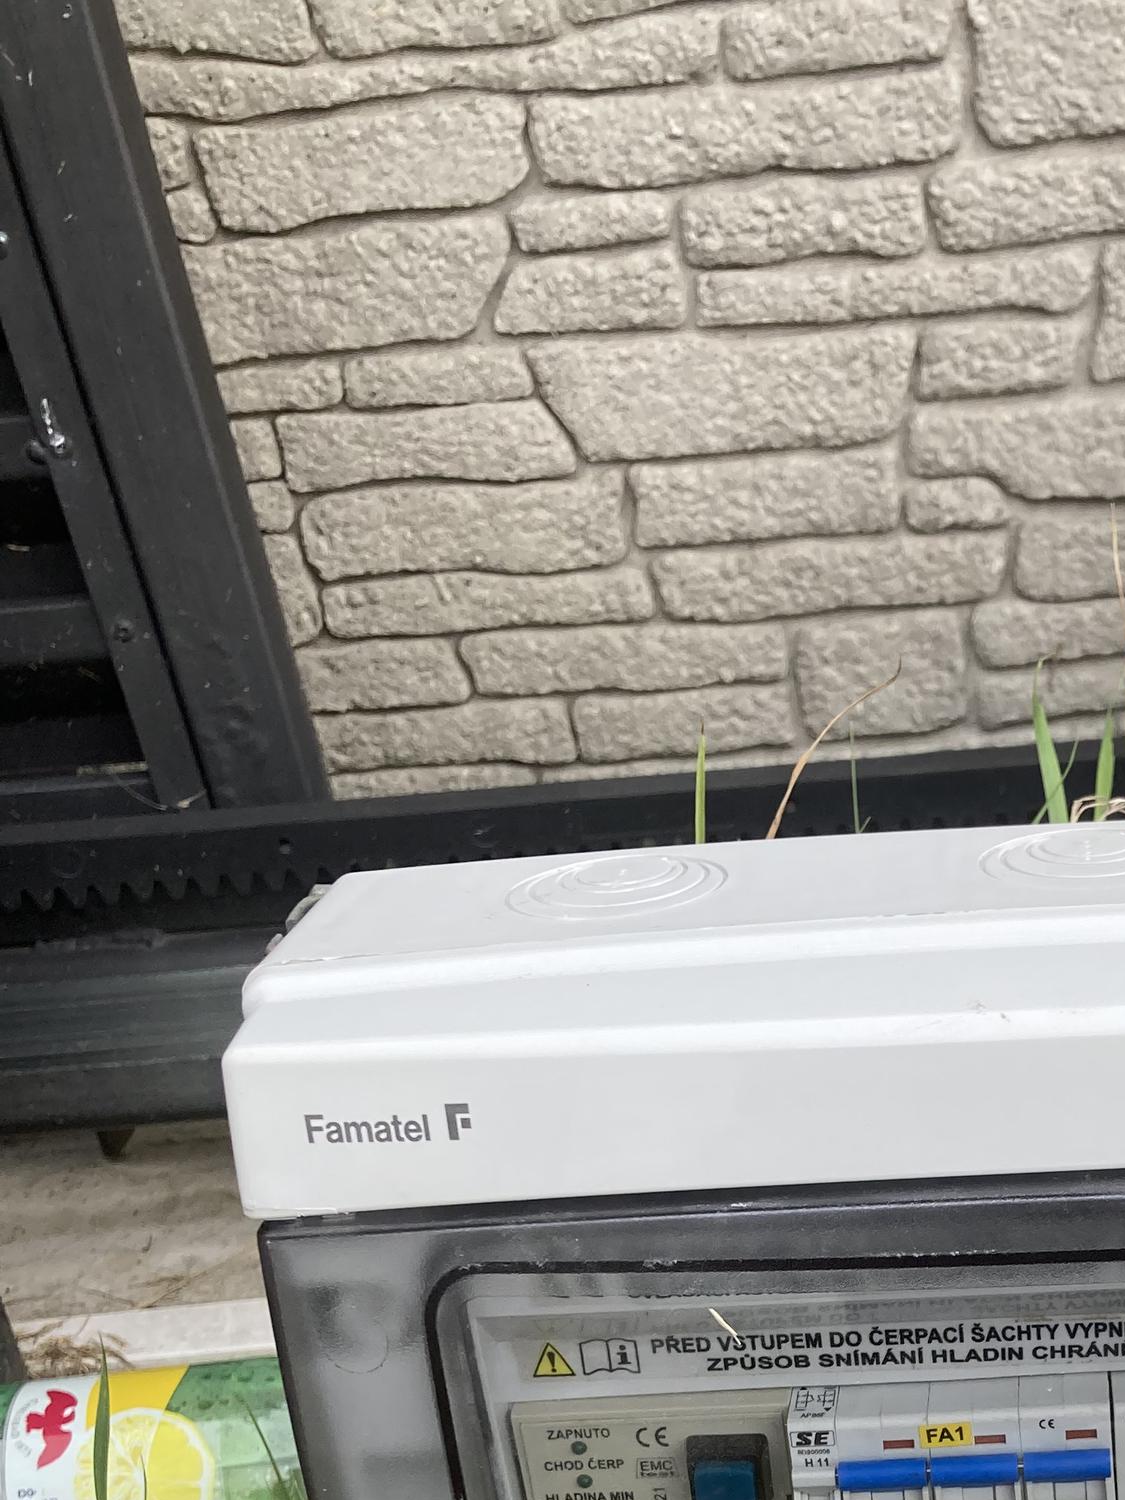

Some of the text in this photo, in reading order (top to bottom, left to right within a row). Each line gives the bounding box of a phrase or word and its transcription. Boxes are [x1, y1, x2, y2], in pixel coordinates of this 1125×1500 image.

[304, 1114, 431, 1143] Famatel
[650, 1335, 711, 1355] PŘED
[717, 1331, 822, 1353] VSTUPEM
[829, 1330, 863, 1348] DO
[868, 1324, 966, 1346] ČERPACÍ
[971, 1322, 1059, 1343] ŠACHTY
[707, 1353, 811, 1372] ZPŮSOB
[818, 1348, 924, 1367] SNÍMÁNÍ
[931, 1345, 1024, 1364] HLADIN
[547, 1428, 610, 1440] ZAPNUTO
[796, 1432, 830, 1446] SE
[926, 1426, 966, 1445] FA1
[544, 1457, 624, 1471] CHOD ČERP
[640, 1460, 673, 1471] EMC
[653, 1487, 667, 1500] 21
